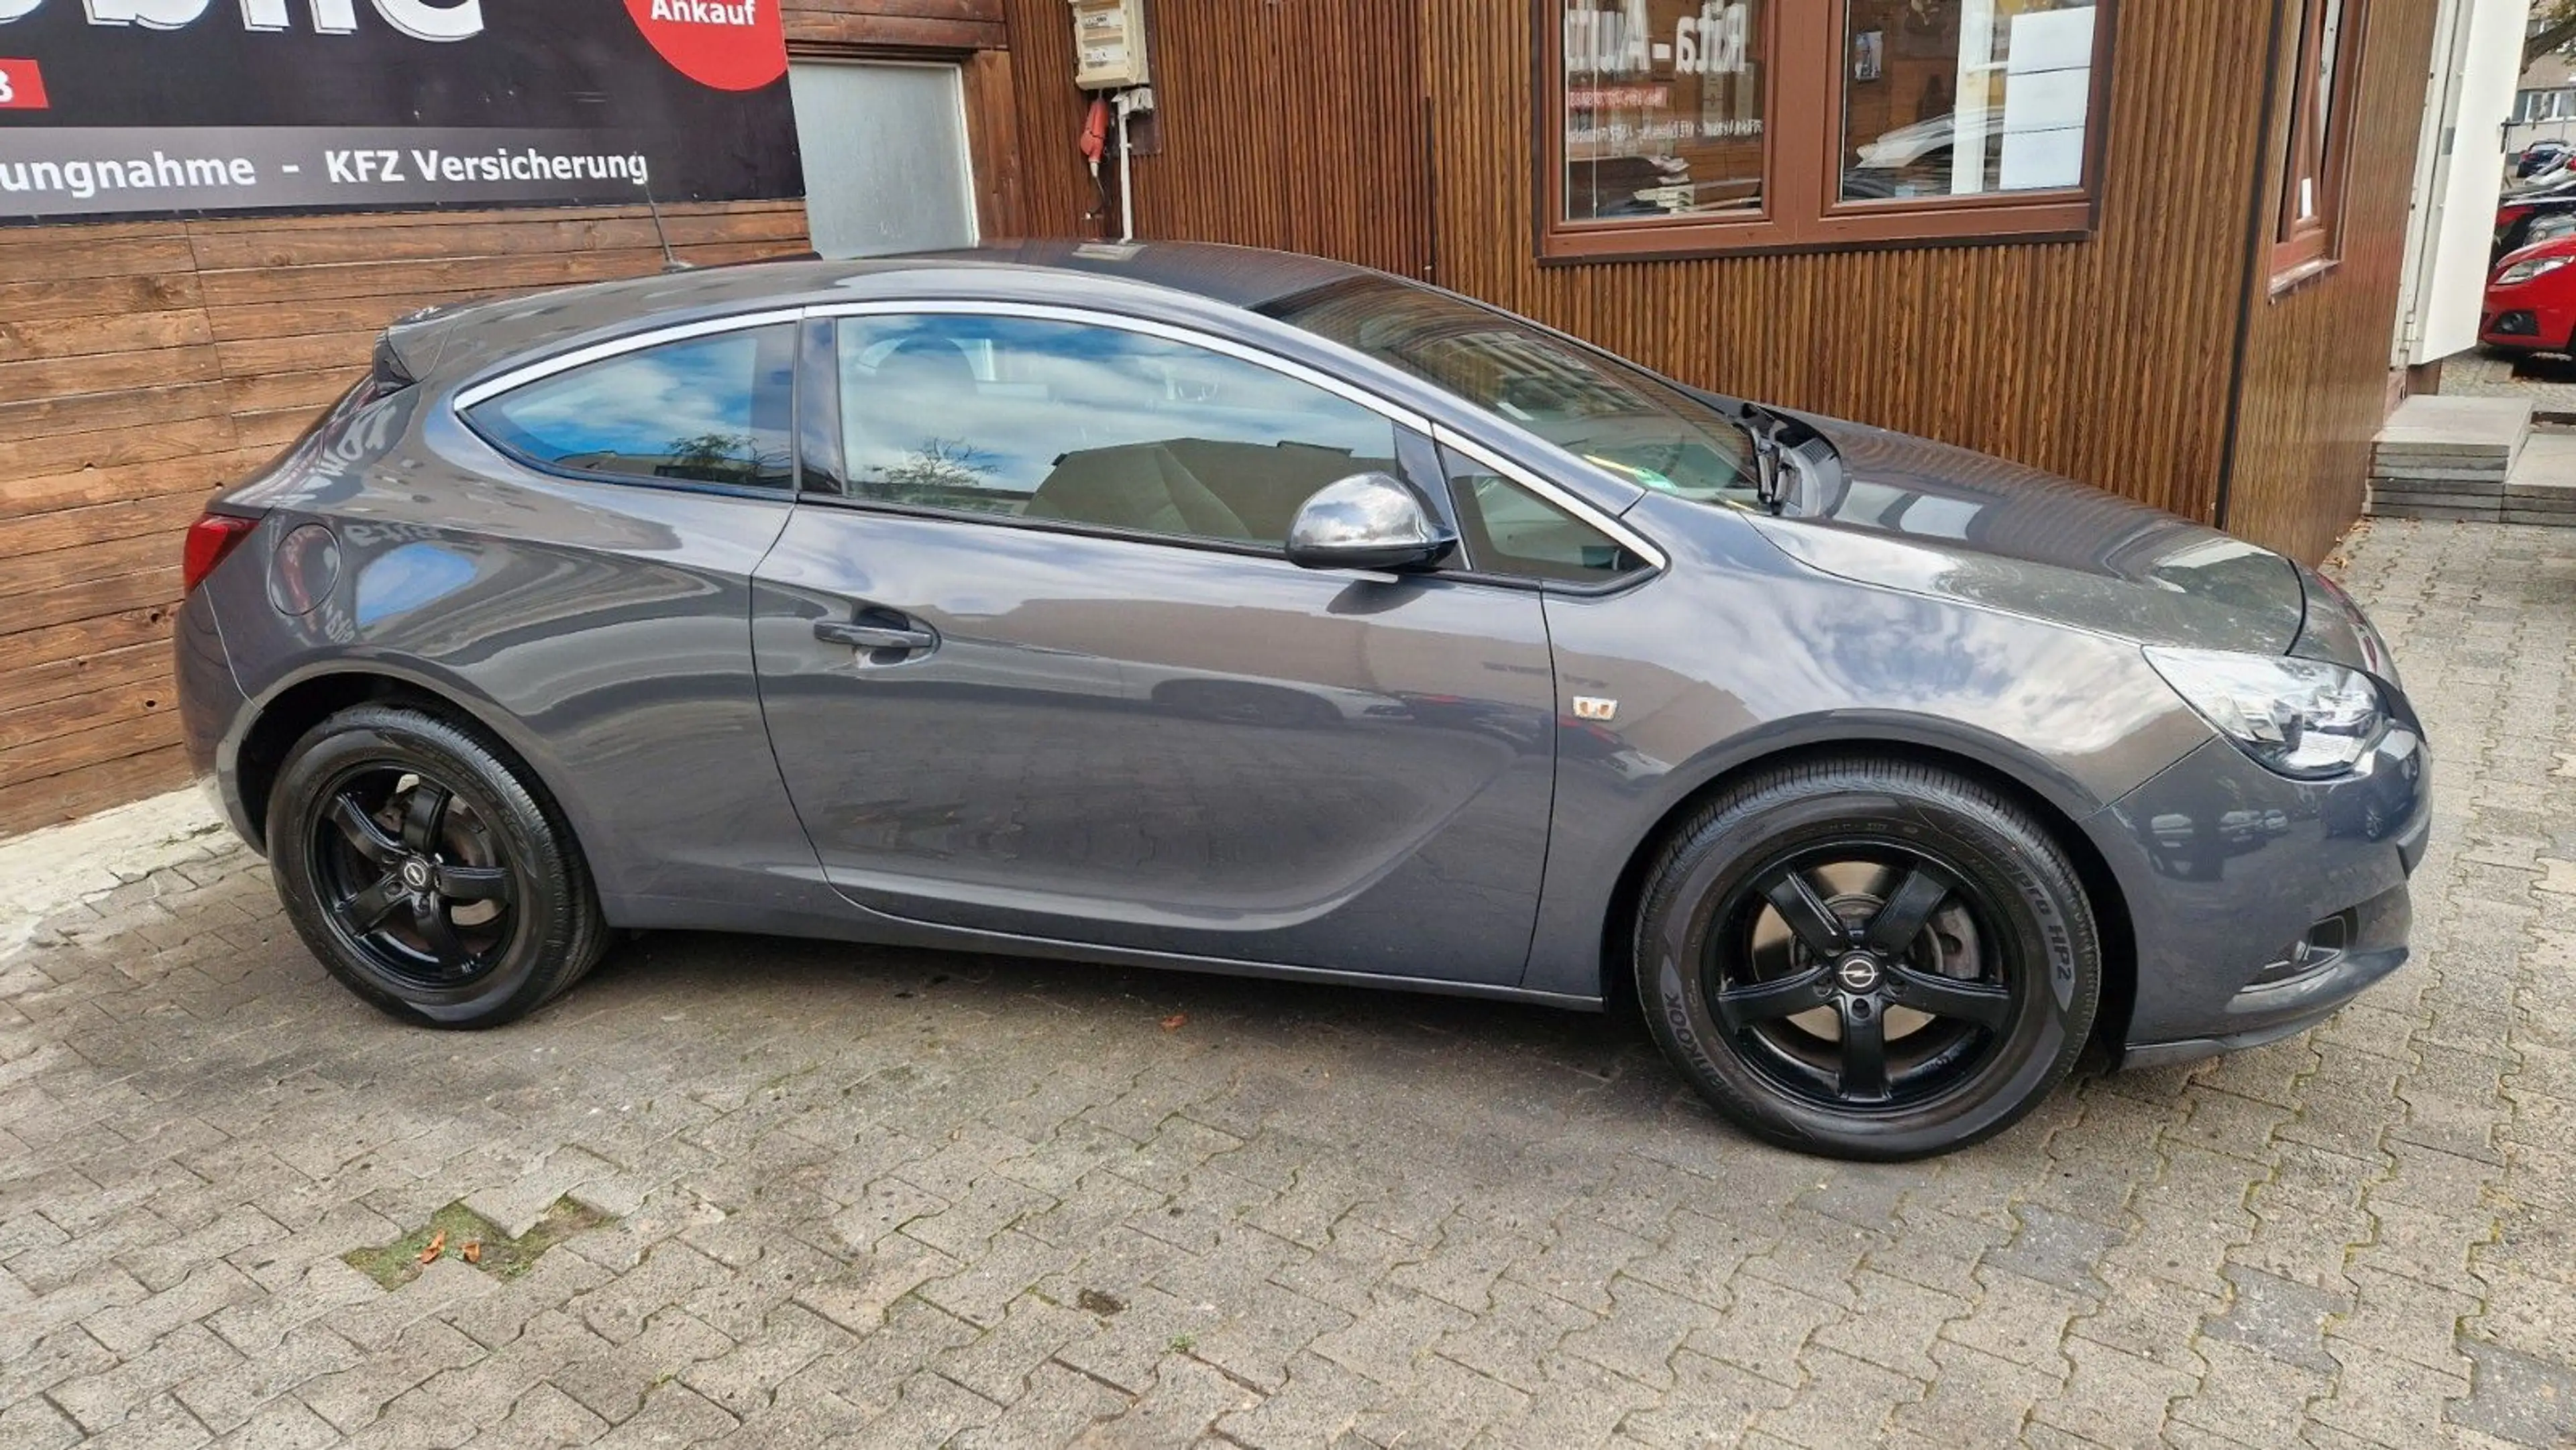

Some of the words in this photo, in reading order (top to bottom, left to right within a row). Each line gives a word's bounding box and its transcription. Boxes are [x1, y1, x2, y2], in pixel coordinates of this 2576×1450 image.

[651, 0, 755, 25] Ankauf
[325, 150, 405, 182] KFZ
[411, 148, 648, 184] Versicherung
[2047, 924, 2072, 981] HP2
